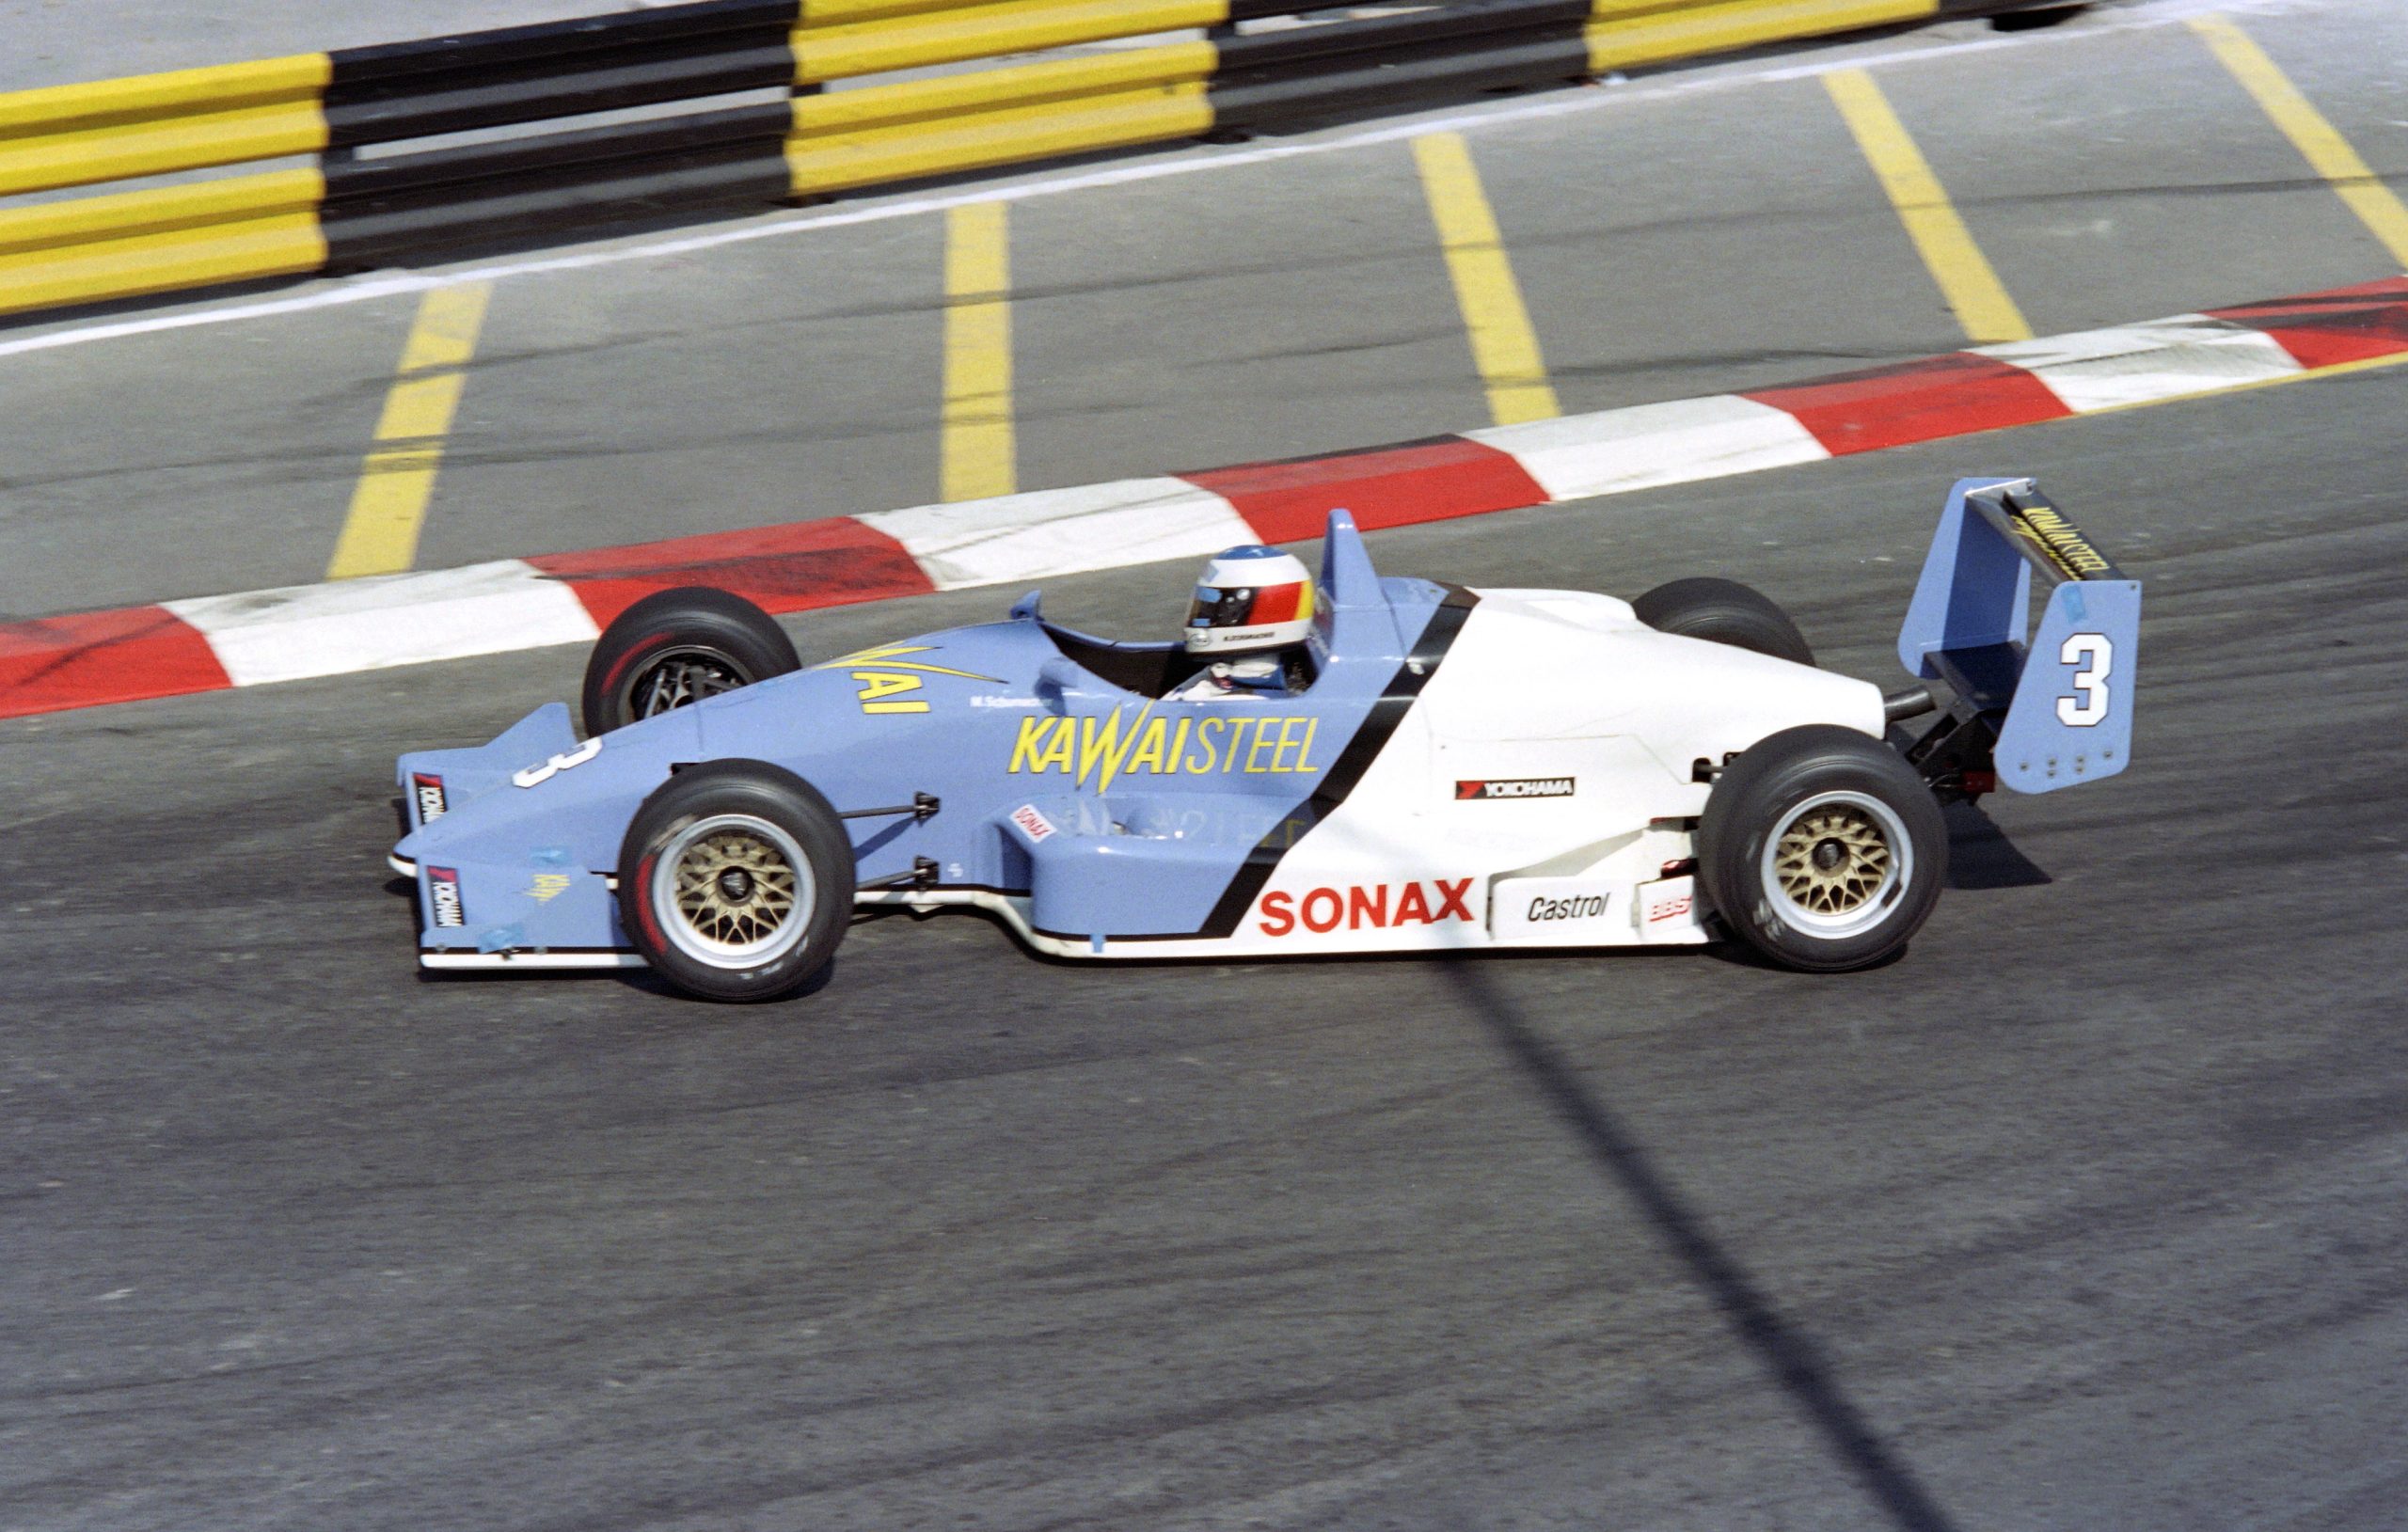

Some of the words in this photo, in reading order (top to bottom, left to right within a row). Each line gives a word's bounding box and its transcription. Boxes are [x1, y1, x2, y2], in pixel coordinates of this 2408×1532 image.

[2056, 632, 2114, 727] 3
[511, 735, 603, 789] 3
[1007, 699, 1319, 797] KAWAISTEEL
[1483, 779, 1574, 798] YOKOHAMA
[1259, 877, 1475, 937] SONAX
[1528, 892, 1610, 922] Castrol
